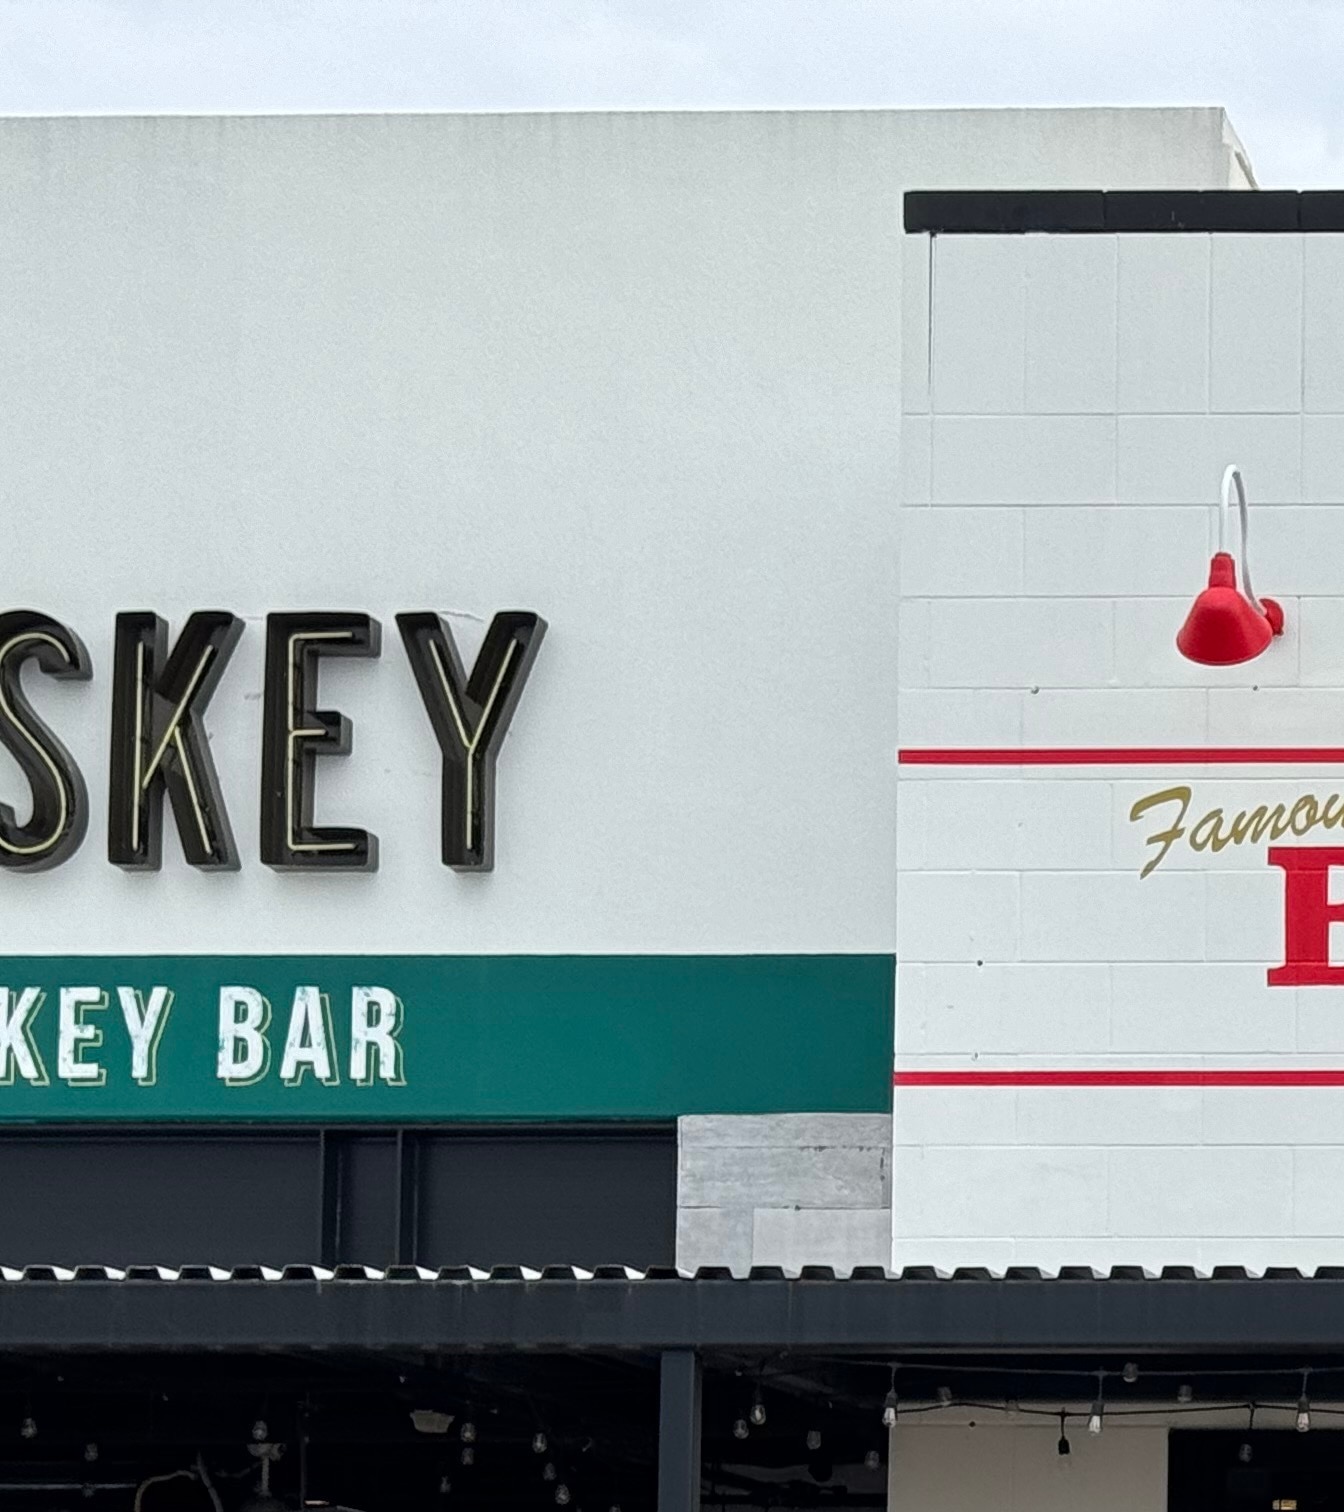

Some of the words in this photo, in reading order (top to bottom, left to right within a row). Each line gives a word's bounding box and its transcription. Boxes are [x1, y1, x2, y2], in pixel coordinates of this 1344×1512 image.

[0, 610, 549, 874] SKEY
[0, 986, 174, 1087] KEY
[216, 986, 407, 1087] BAR
